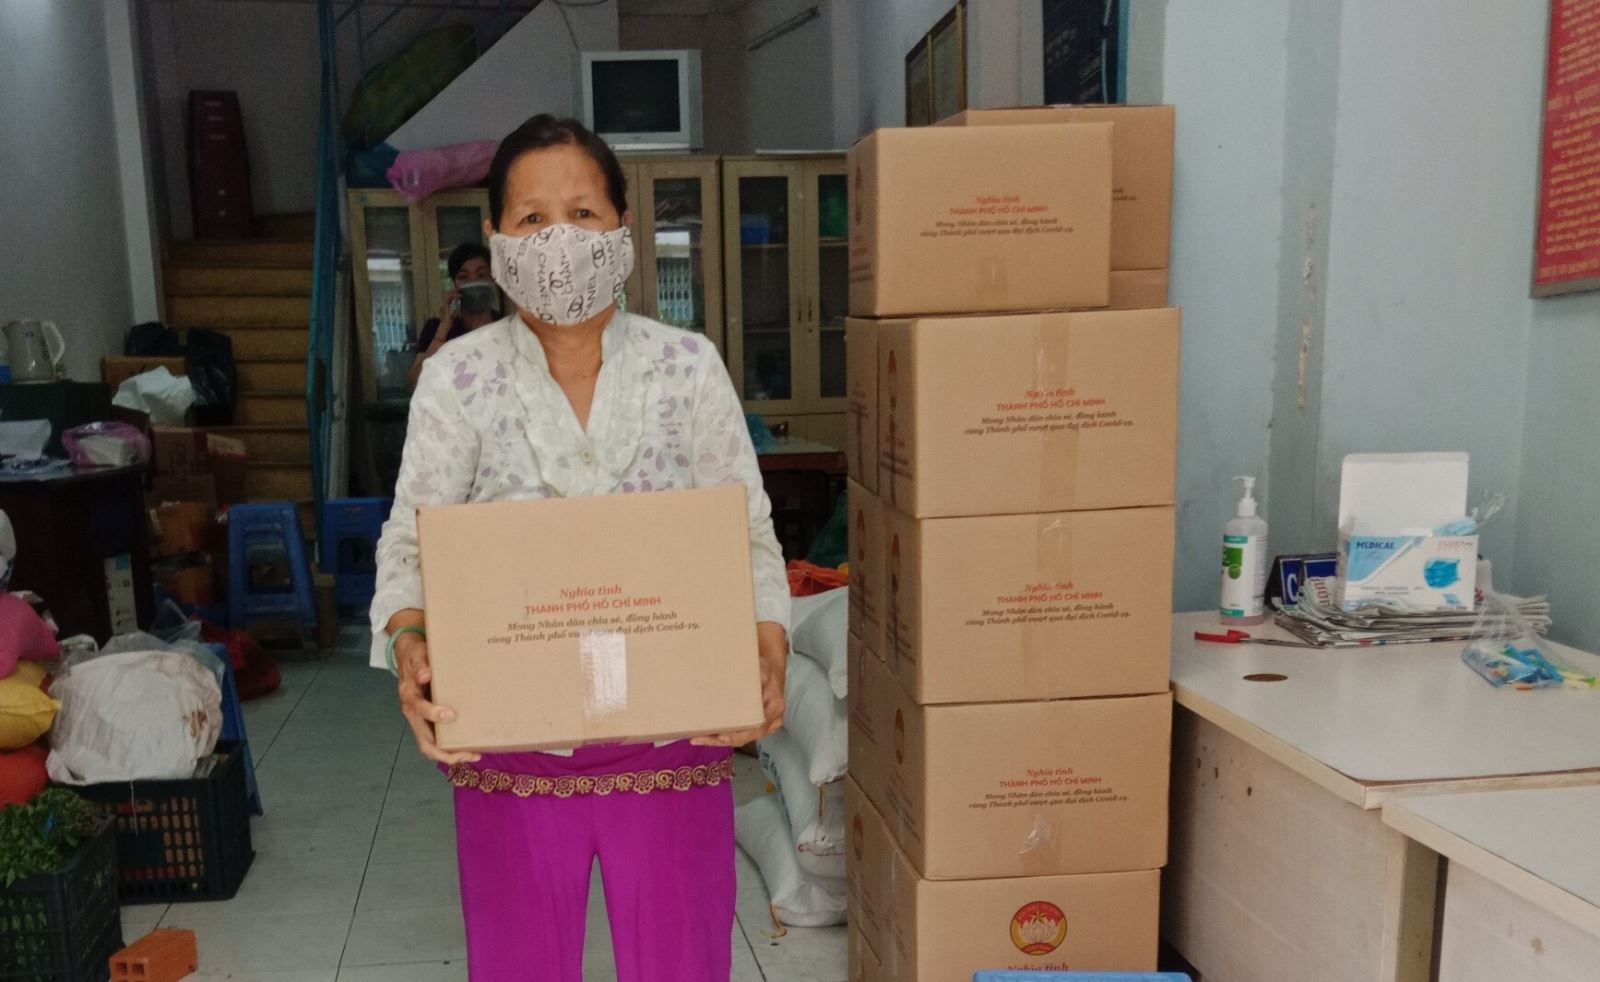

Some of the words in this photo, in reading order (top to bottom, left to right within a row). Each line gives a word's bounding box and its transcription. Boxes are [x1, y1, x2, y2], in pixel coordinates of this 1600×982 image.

[560, 586, 595, 599] Nghĩa
[598, 584, 622, 595] tình
[524, 602, 563, 615] THÀNH
[566, 599, 590, 612] PHỐ
[593, 597, 609, 610] HỒ
[612, 596, 631, 609] CHÍ
[633, 596, 661, 606] MINH
[507, 622, 536, 631] Mong
[538, 619, 564, 629] Nhân
[566, 618, 585, 627] dân
[587, 615, 608, 625] chia
[652, 610, 677, 621] hành
[487, 635, 512, 645] cùng
[514, 631, 545, 642] Thành
[547, 629, 567, 642] phố
[615, 625, 631, 635] đại
[633, 624, 654, 634] dịch
[656, 621, 700, 632] Covid-19.
